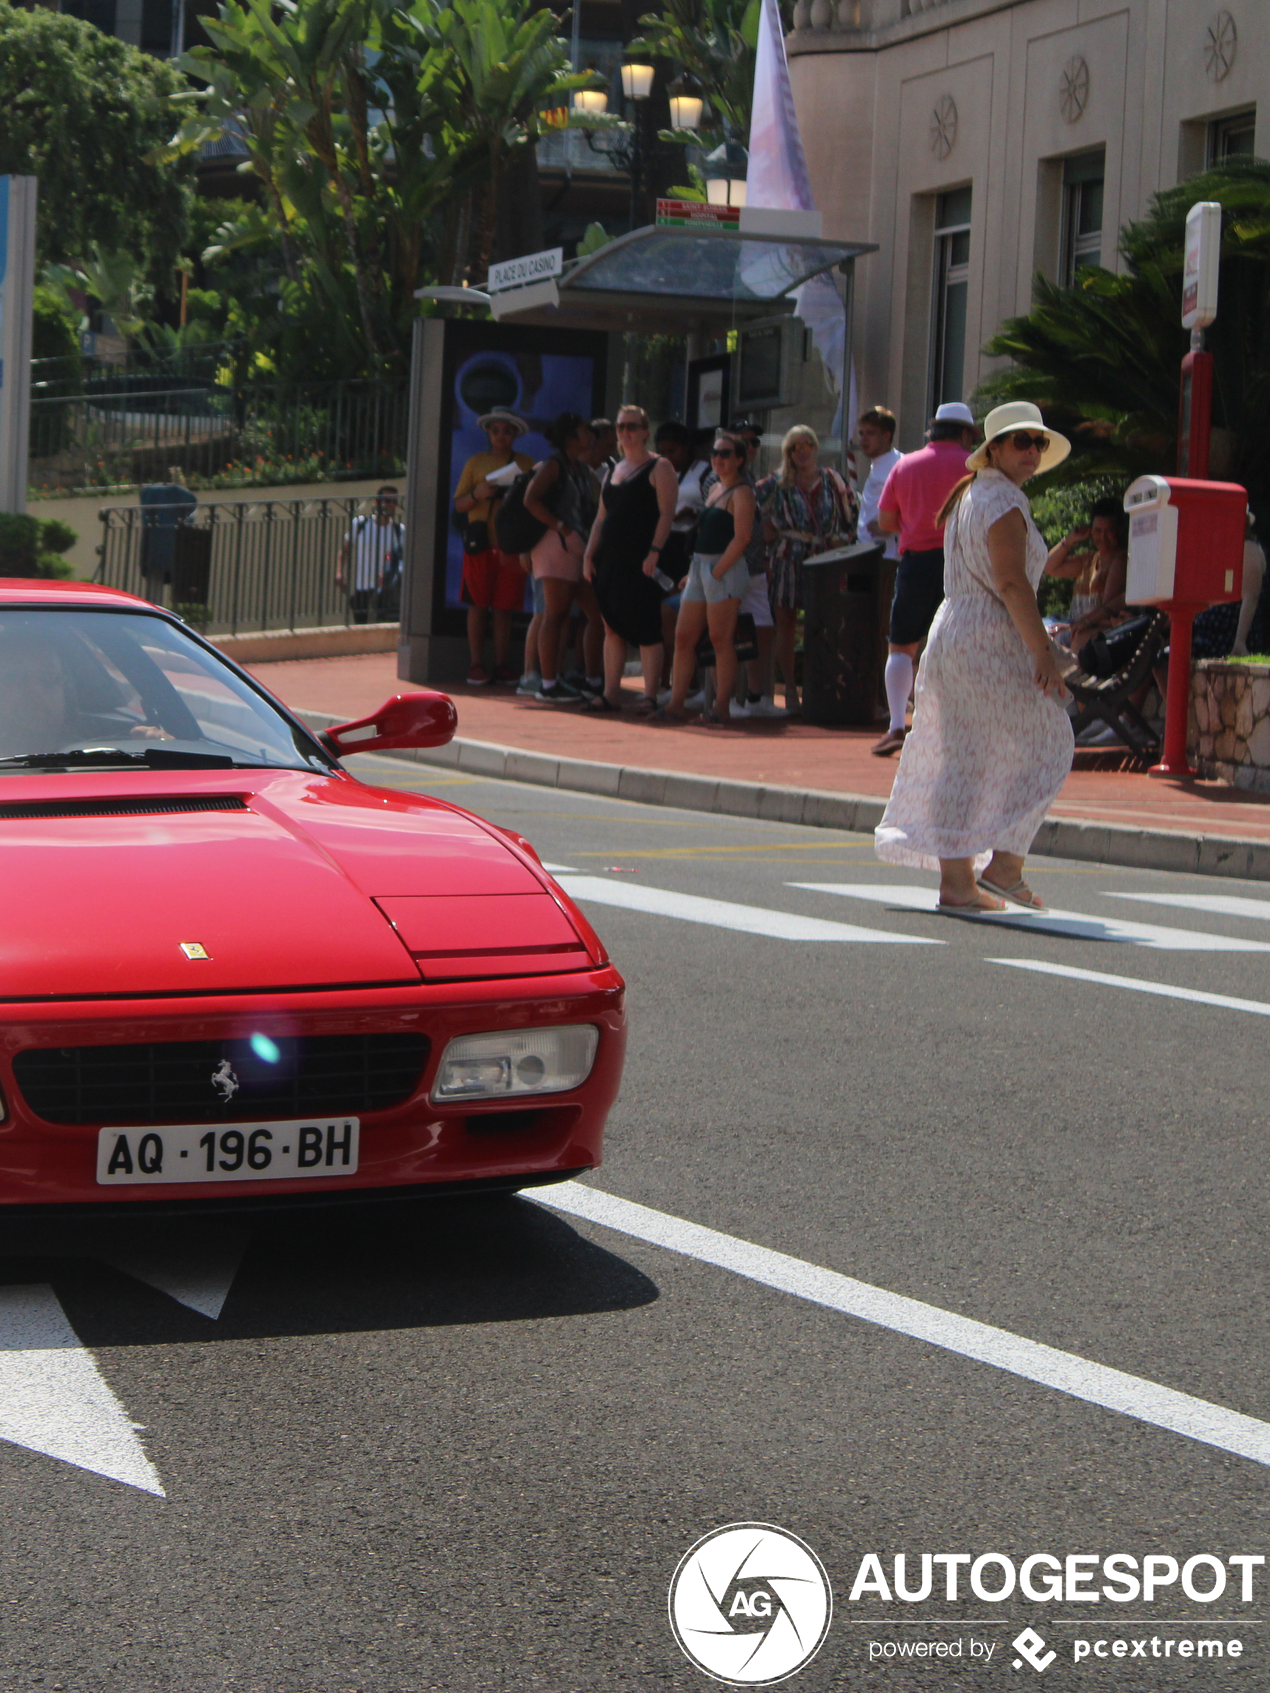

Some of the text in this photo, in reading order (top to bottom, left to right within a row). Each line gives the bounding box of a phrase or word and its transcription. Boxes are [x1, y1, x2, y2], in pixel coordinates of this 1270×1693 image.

[495, 255, 555, 283] PLACE DU CASINO
